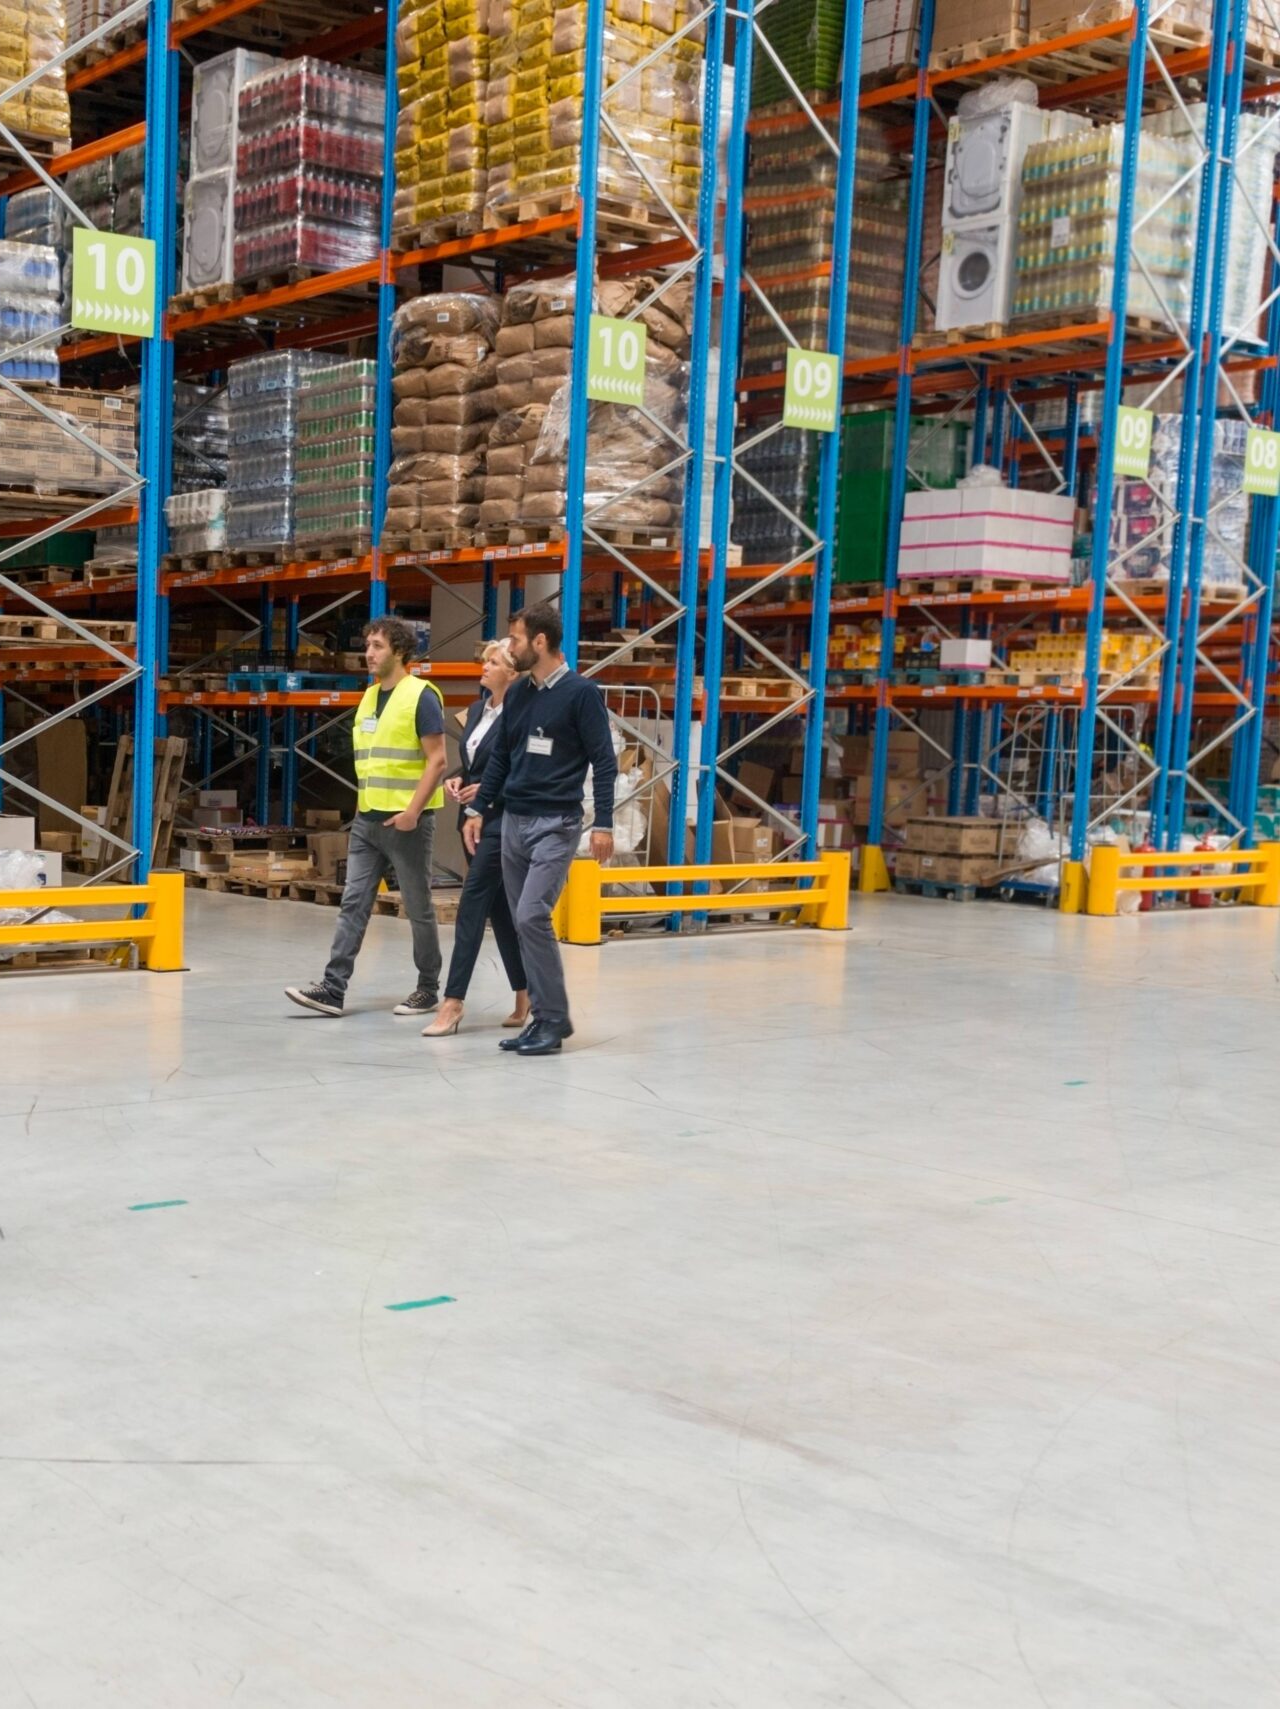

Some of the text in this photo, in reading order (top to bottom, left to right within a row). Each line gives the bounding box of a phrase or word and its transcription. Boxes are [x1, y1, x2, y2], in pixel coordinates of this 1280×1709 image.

[87, 242, 145, 296] 10
[599, 327, 639, 371] 10
[793, 358, 832, 399] 09
[1120, 415, 1148, 450] 09
[1250, 435, 1278, 470] 08
